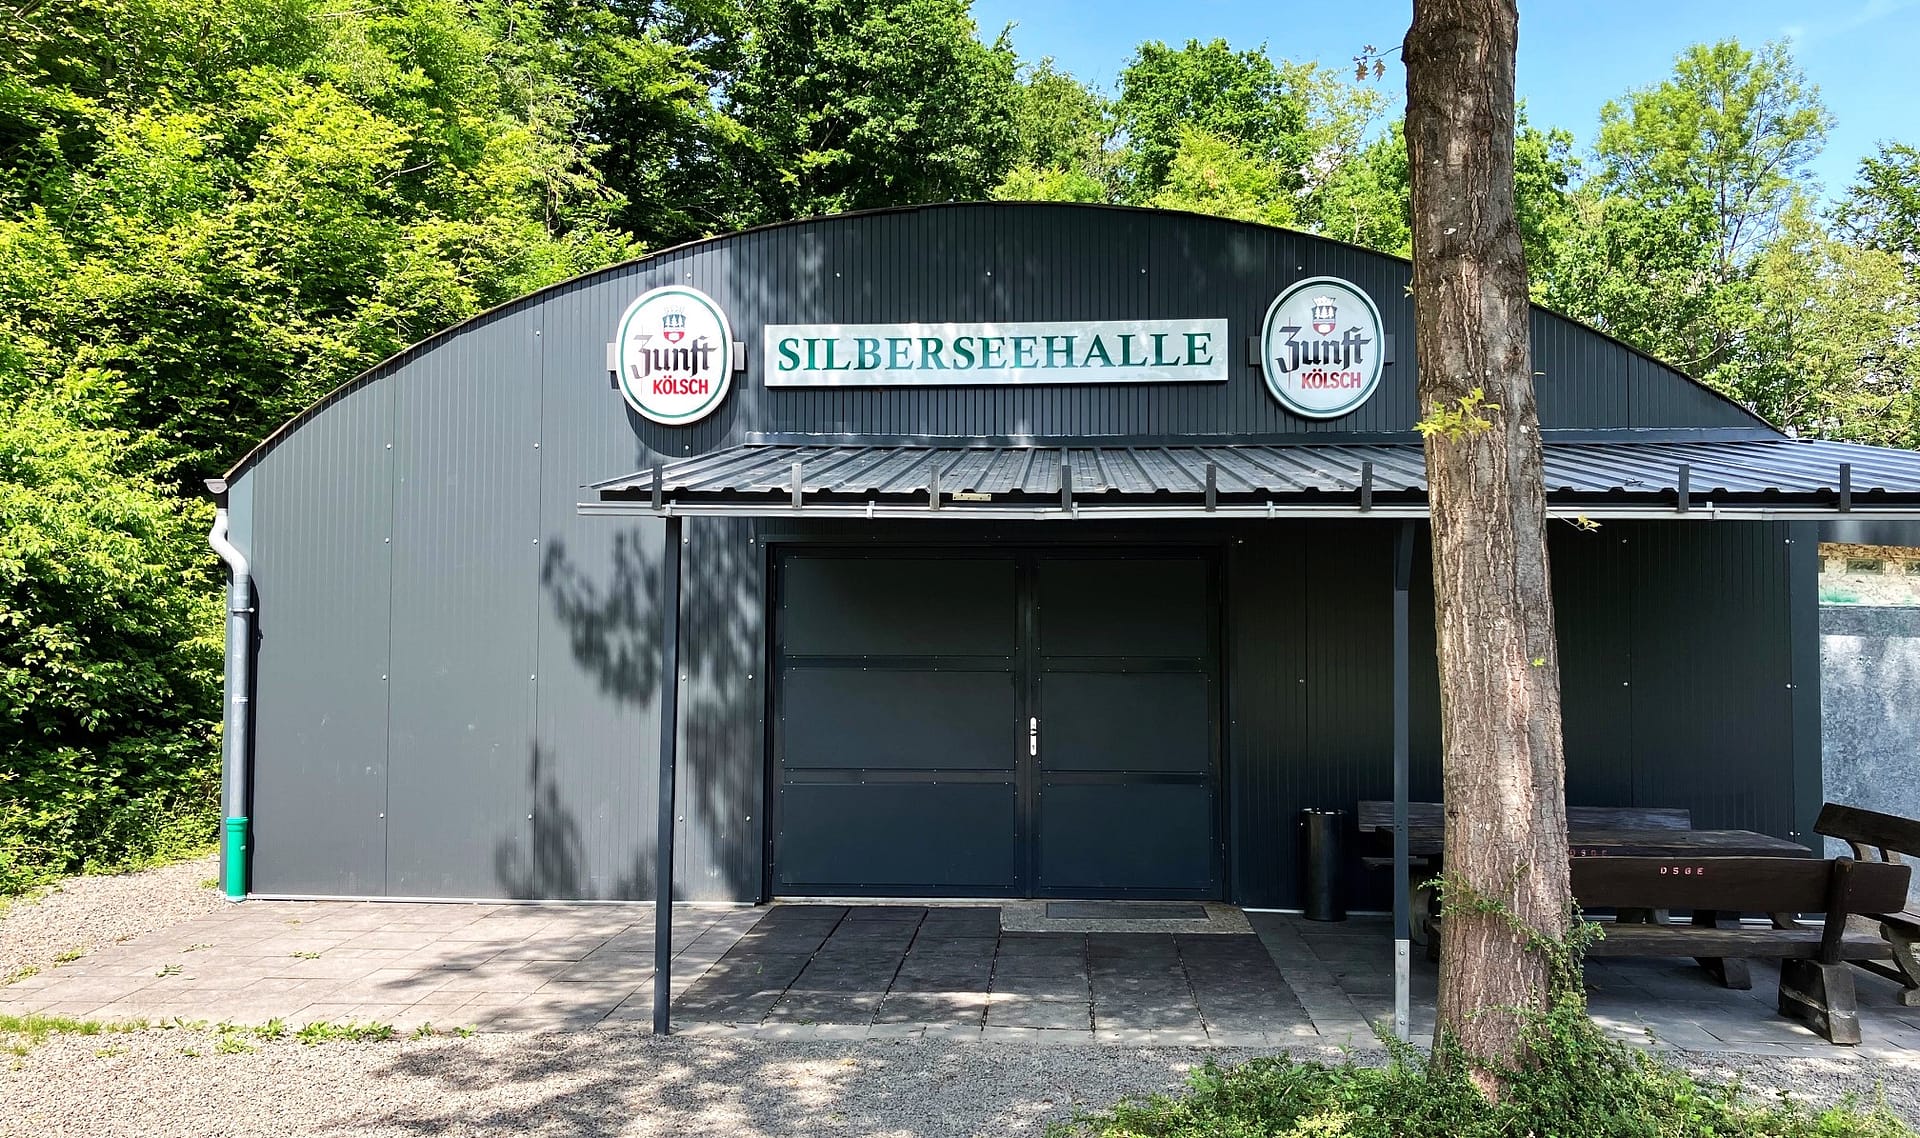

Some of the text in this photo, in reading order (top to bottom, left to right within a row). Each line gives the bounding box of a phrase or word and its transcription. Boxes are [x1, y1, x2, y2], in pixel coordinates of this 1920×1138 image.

[630, 334, 719, 380] Zunft
[777, 332, 1215, 372] SILBERSEEHALLE
[1274, 326, 1373, 374] Zunft
[653, 375, 709, 395] KÖLSCH
[1301, 368, 1362, 389] KÖLSCH
